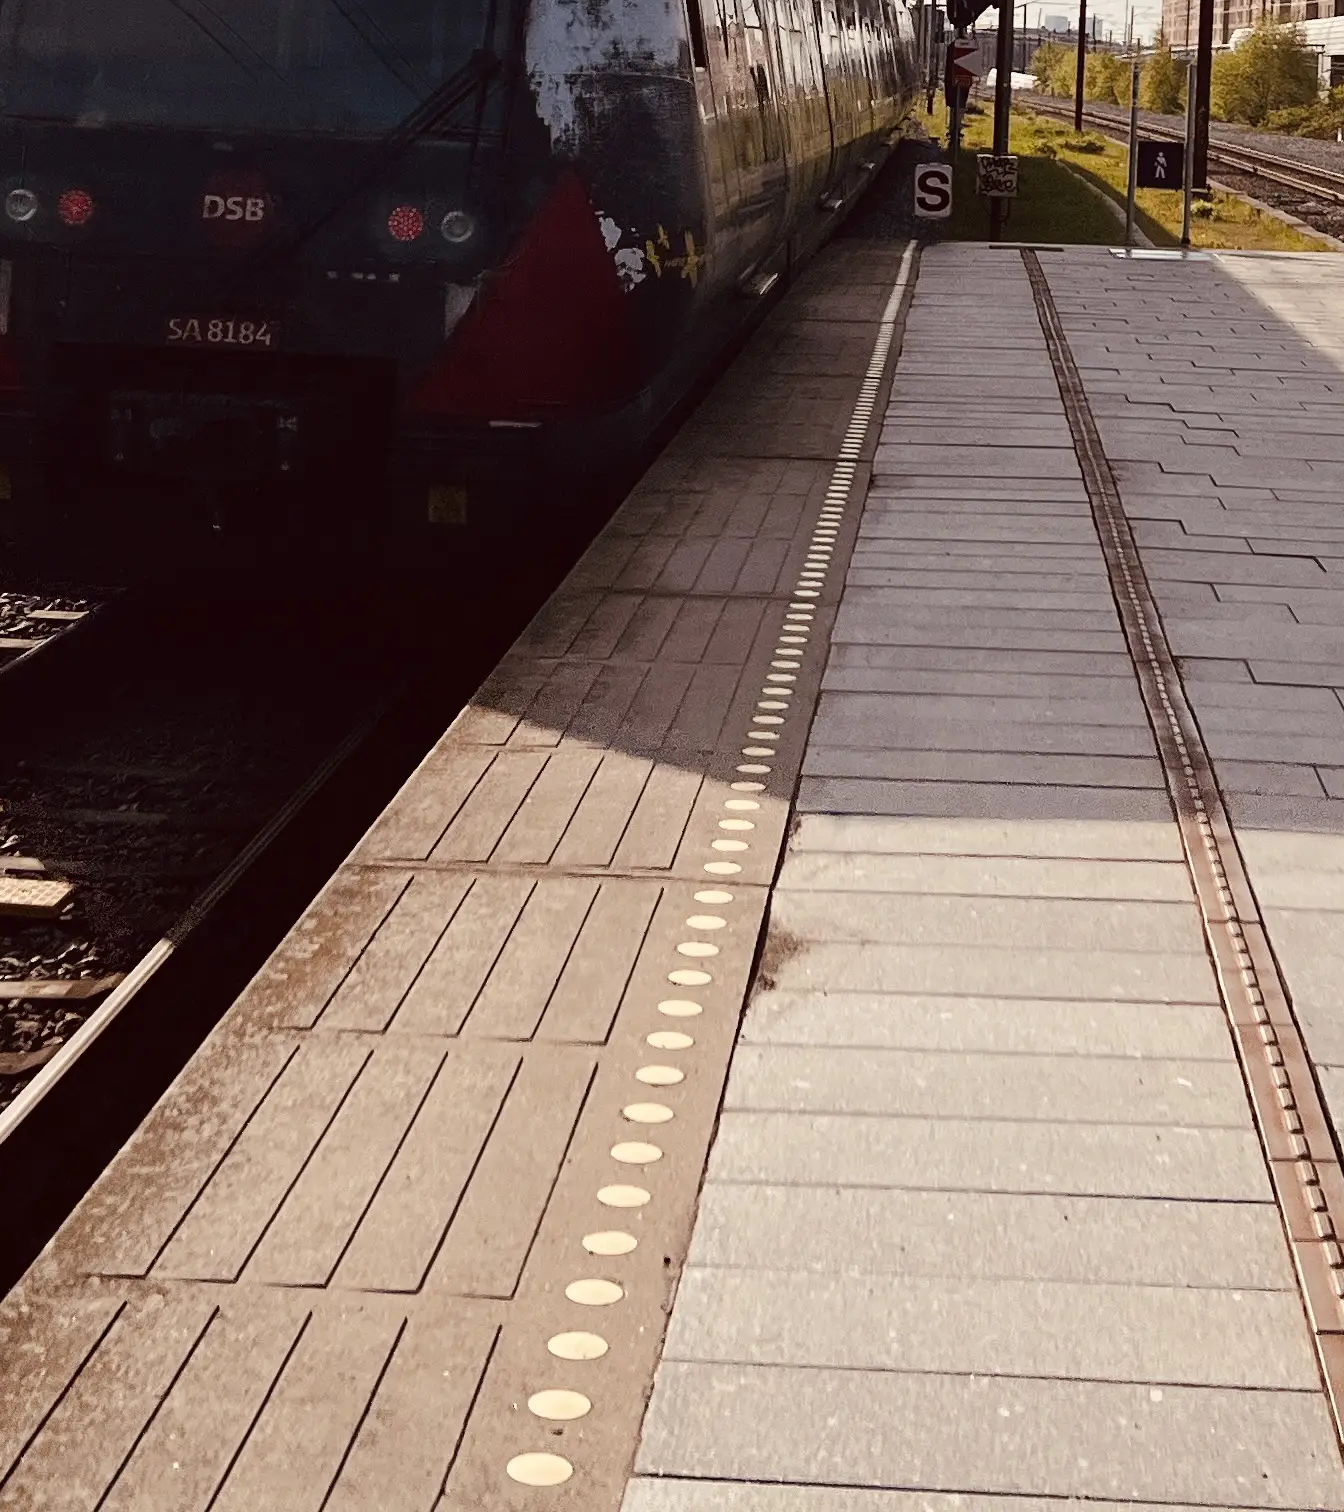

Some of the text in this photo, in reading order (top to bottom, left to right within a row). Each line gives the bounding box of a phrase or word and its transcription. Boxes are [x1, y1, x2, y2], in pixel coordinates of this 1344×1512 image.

[917, 170, 950, 212] S
[202, 194, 265, 221] DSB
[168, 318, 271, 346] SA 8184
